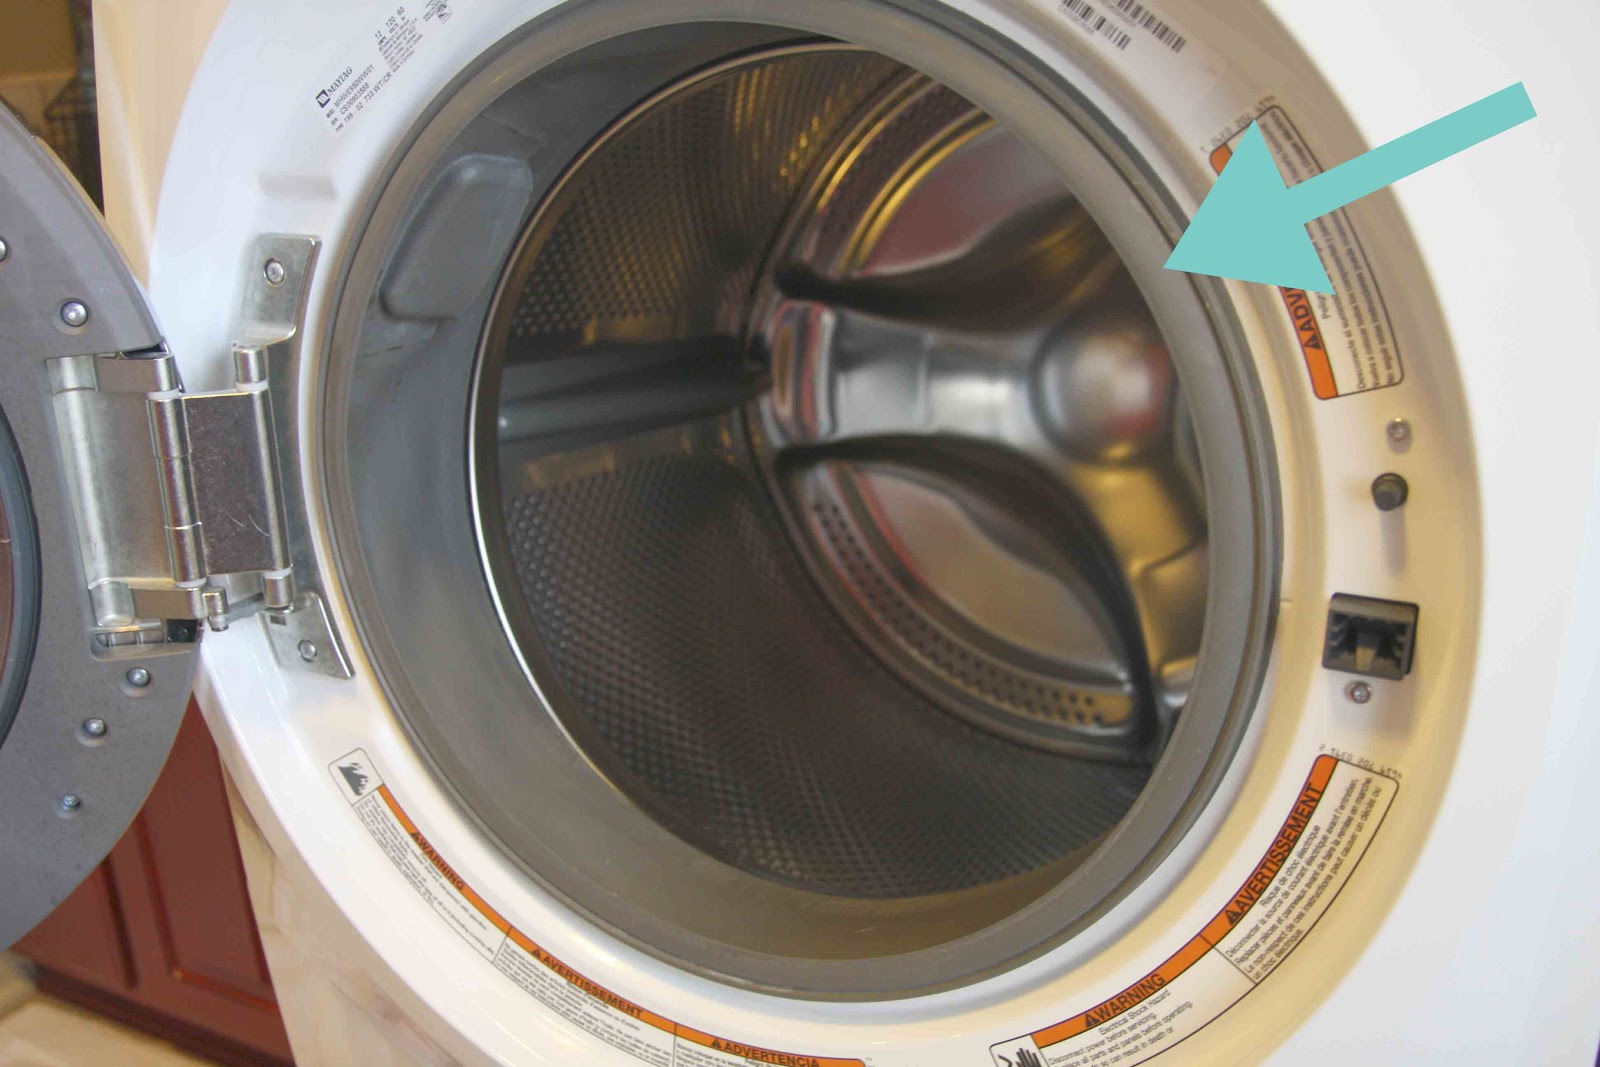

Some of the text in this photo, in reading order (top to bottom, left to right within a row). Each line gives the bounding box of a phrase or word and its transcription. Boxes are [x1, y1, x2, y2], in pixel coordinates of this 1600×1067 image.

[374, 30, 383, 40] 12
[385, 16, 397, 28] 120
[326, 67, 354, 95] MAYTAG
[415, 836, 467, 891] WARNING
[1233, 782, 1323, 914] AVERTISSEMENT
[542, 955, 645, 1019] AVERTISSEMENT
[1093, 971, 1167, 1022] WARNING
[723, 1041, 820, 1067] ADVERTENCIA
